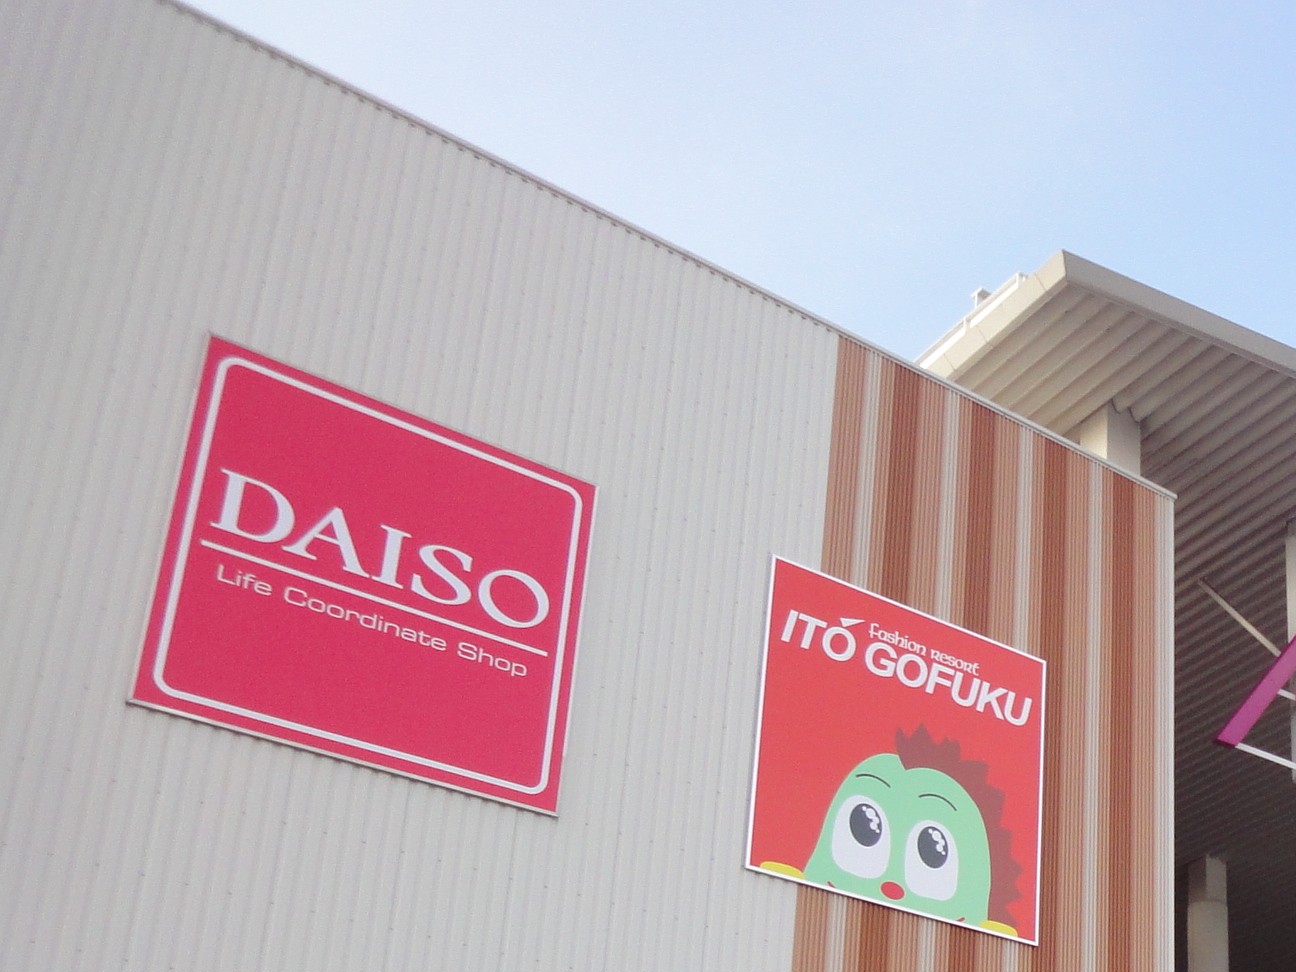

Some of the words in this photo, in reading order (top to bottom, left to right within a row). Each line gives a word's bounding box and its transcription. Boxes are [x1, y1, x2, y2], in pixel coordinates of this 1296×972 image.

[210, 468, 549, 628] DAISO
[216, 564, 272, 596] Life
[284, 586, 447, 651] Coordinate
[457, 642, 527, 677] Shop
[868, 622, 927, 656] fashion
[865, 642, 1032, 726] GOFUKU
